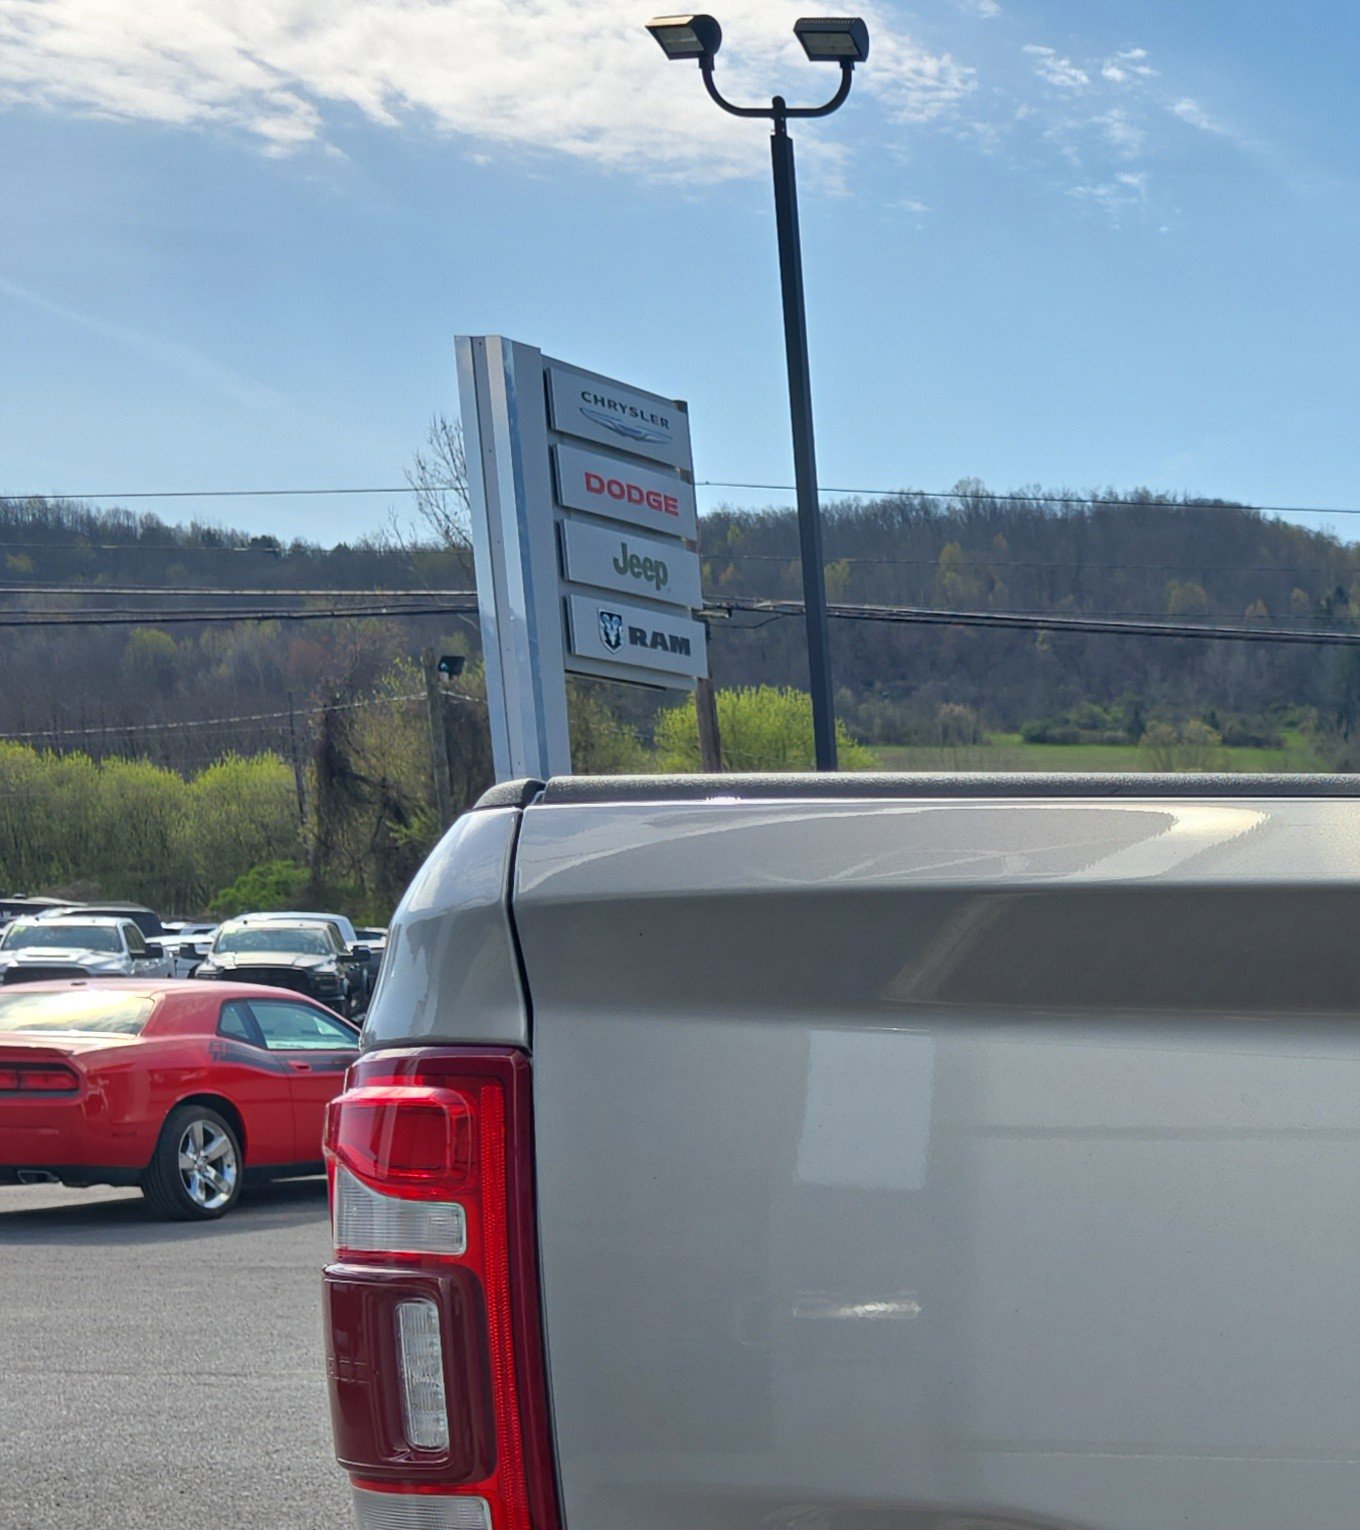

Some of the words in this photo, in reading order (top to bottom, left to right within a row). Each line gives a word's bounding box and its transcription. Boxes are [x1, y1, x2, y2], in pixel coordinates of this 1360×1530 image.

[580, 391, 670, 429] CHRYSLER
[585, 473, 679, 515] DODGE
[612, 542, 669, 590] Jeep
[629, 626, 691, 656] RAM
